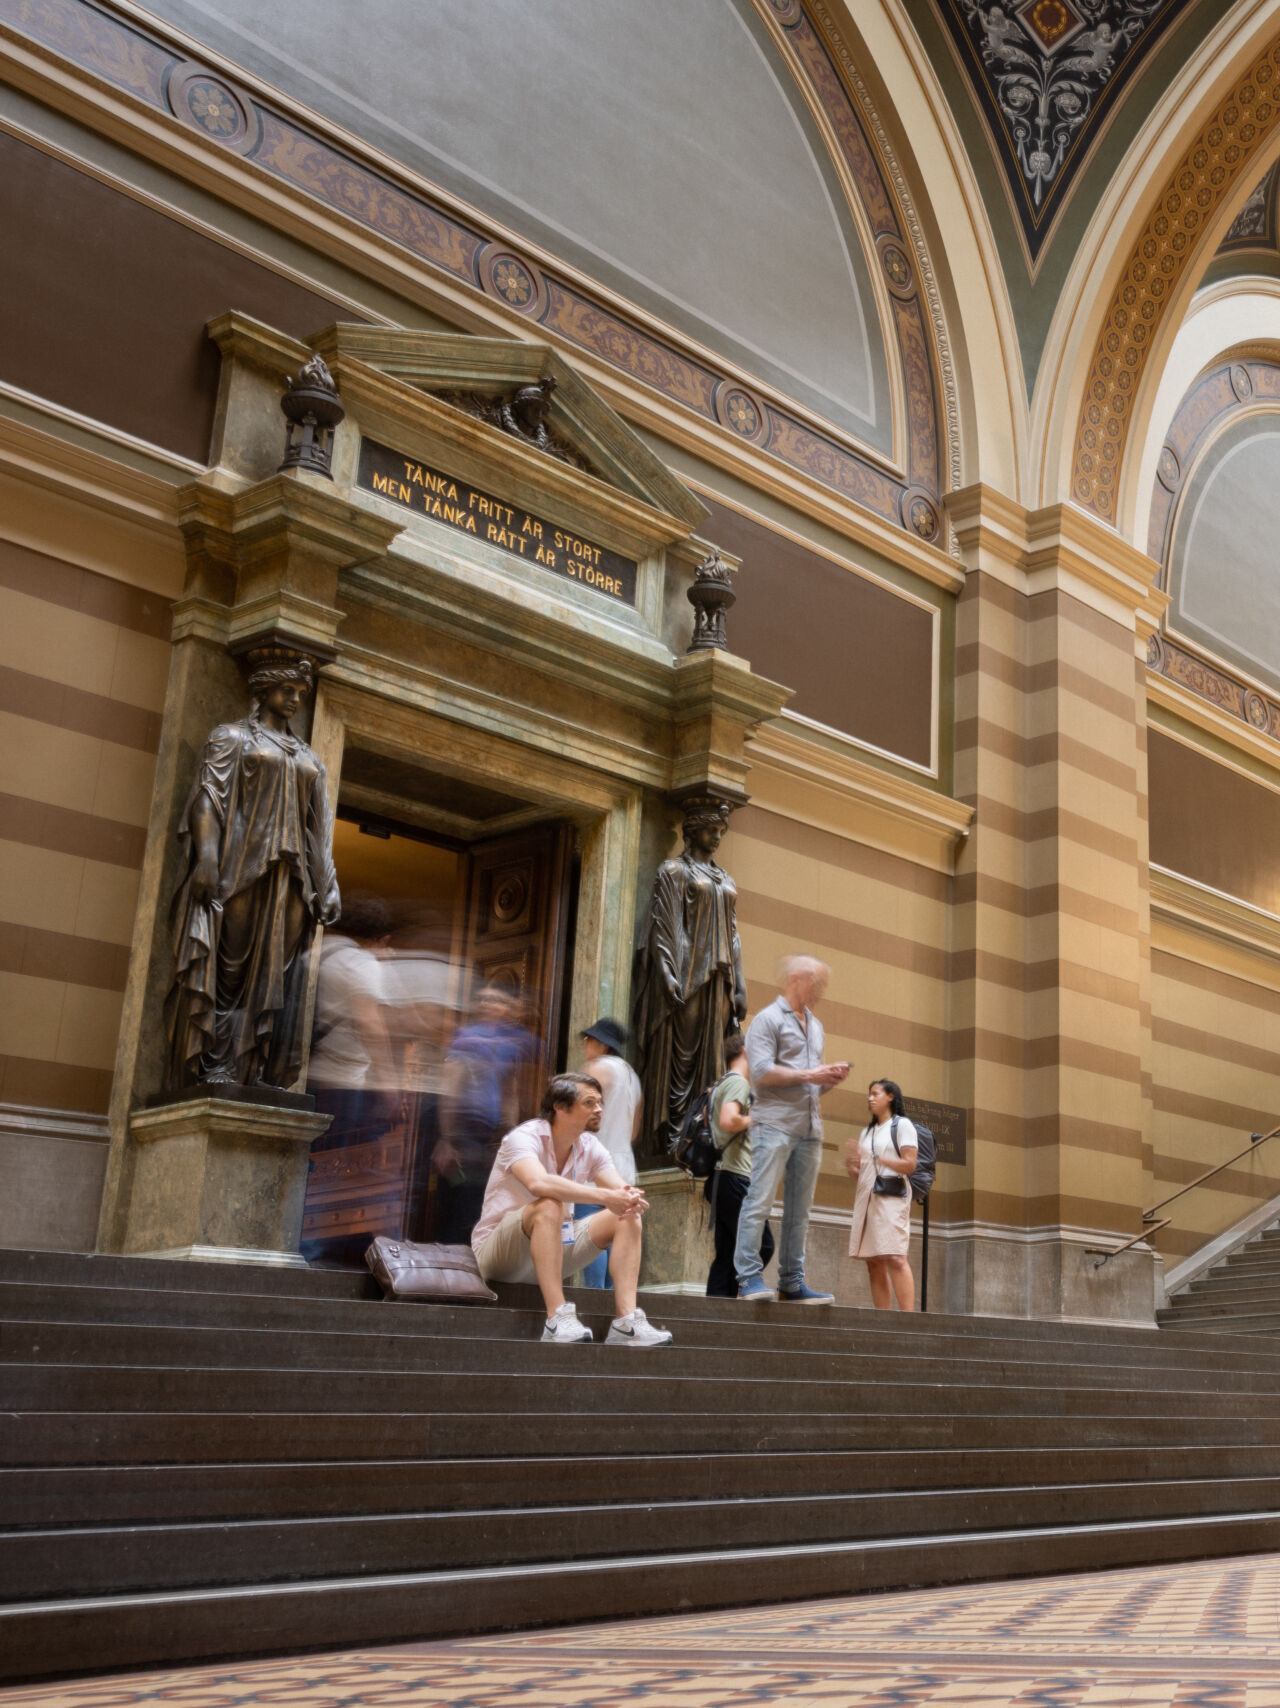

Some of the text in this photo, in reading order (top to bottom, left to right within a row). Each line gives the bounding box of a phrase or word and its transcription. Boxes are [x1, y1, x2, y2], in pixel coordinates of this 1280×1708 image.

[373, 472, 623, 597] MEN TÄNKA RÄTT ÄR STÖRRE
[404, 461, 602, 565] TÄNKA FRITT ÄR STORT
